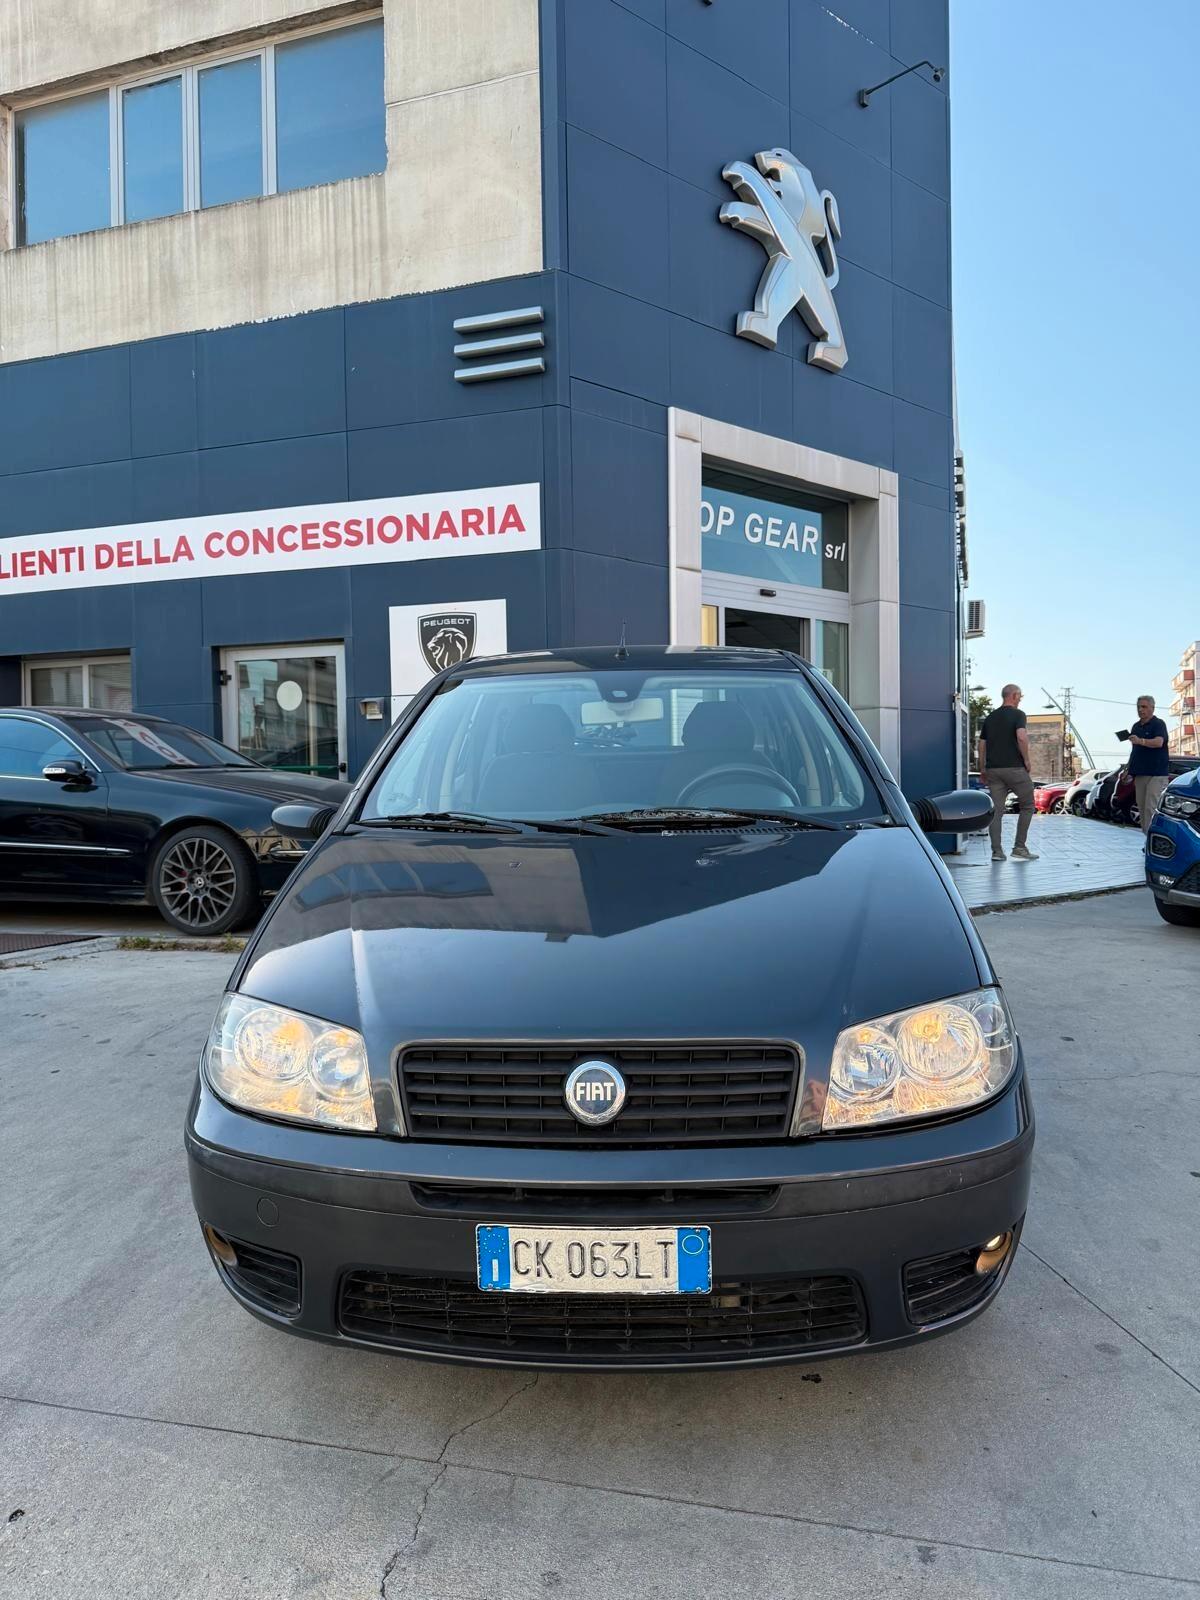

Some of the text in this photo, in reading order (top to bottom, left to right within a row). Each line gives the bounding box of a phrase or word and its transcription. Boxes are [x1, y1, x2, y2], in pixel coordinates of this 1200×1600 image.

[95, 535, 194, 570] DELLA
[204, 503, 526, 559] CONCESSIONARIA
[744, 512, 819, 555] GEAR
[824, 542, 846, 562] srl
[423, 618, 471, 627] PEUGEOT
[576, 1082, 614, 1101] FIAT
[513, 1239, 674, 1279] CK 063LT
